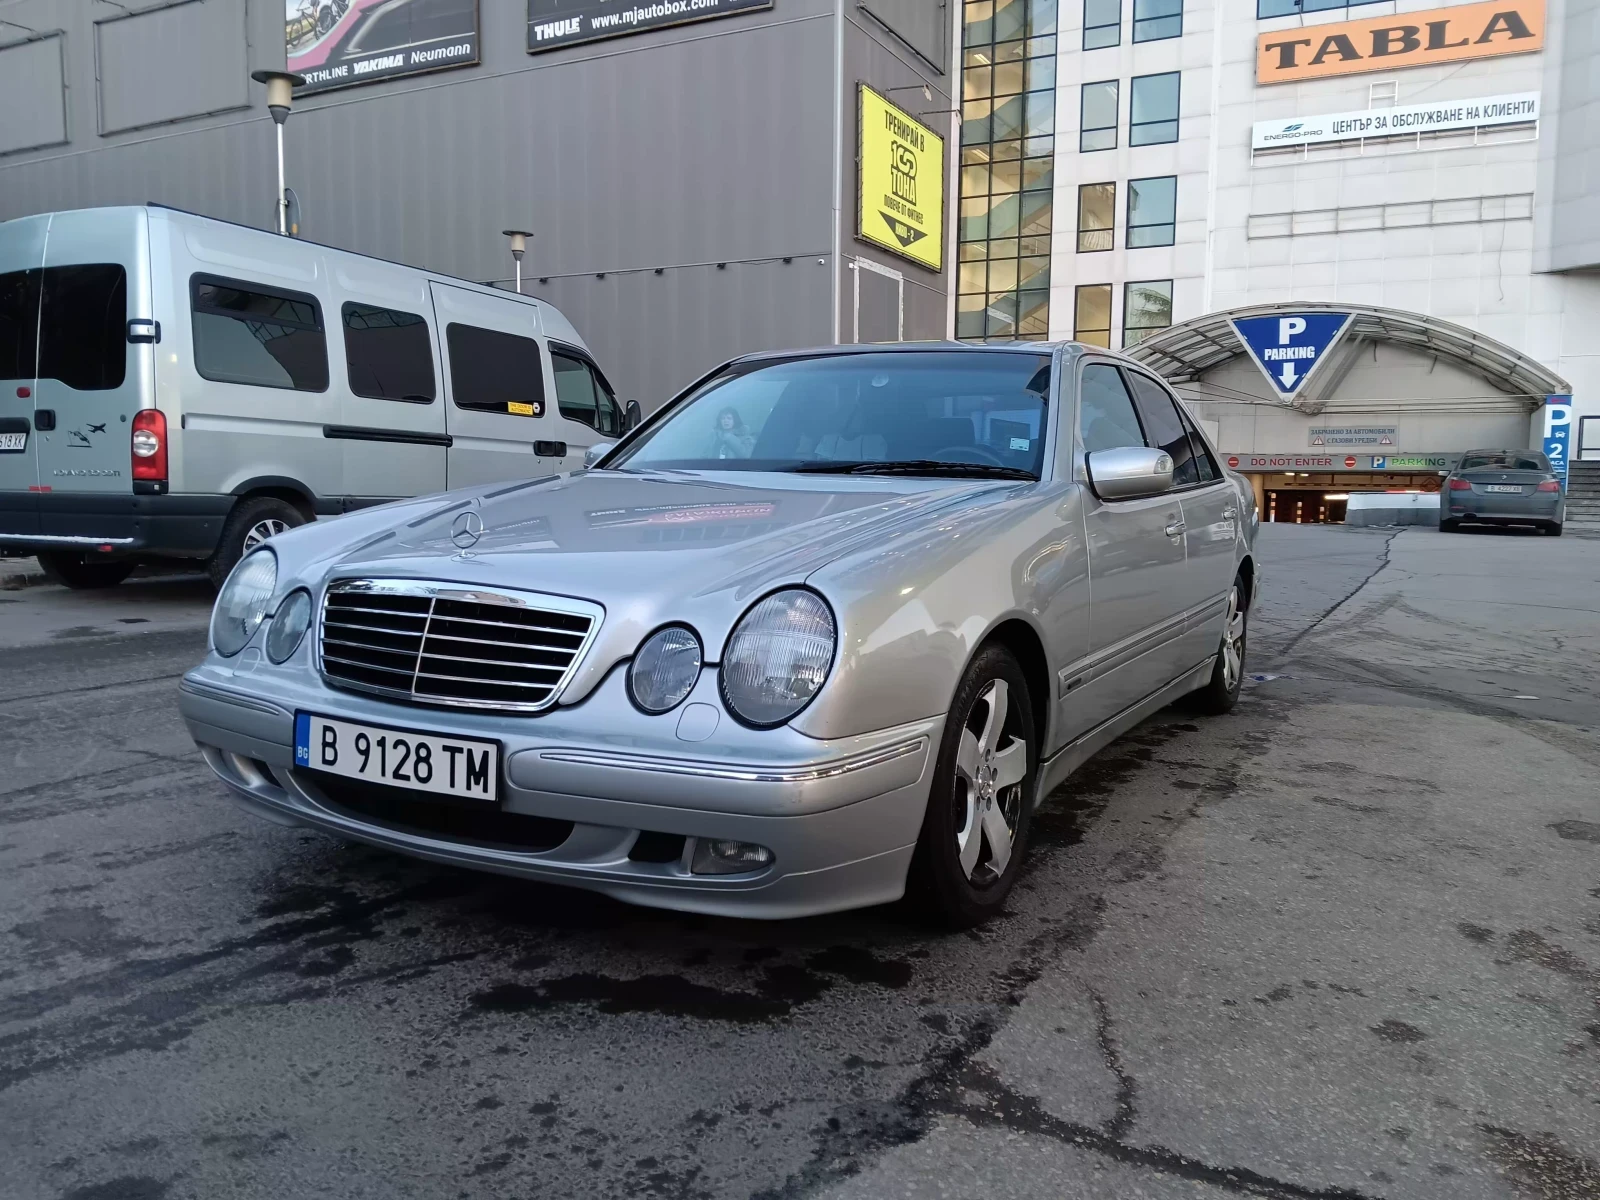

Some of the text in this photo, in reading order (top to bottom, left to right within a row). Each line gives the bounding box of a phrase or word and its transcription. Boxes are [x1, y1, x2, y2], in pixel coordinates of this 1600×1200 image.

[534, 0, 719, 41] THULE www.mjautobox.com
[1265, 10, 1536, 70] TABLA
[301, 43, 471, 85] RTHLINE YAKIMA Neumann
[884, 109, 925, 153] ТРЕНИРАЙ В
[1332, 99, 1536, 135] ЦЕНТЪР ЗА ОБСЛУЖВАНЕ НА КЛИЕНТИ
[1263, 129, 1324, 141] ENERGO-PRO
[891, 166, 917, 207] ТОНА
[1278, 317, 1307, 345] P
[1264, 346, 1316, 361] PARKING
[1353, 427, 1395, 435] АВТОМОБИЛИ
[1250, 458, 1333, 466] DO NOT ENTER
[1391, 458, 1446, 466] PARKING
[1549, 443, 1563, 459] 2
[296, 745, 309, 760] BG
[321, 724, 490, 794] B 9128 TM
